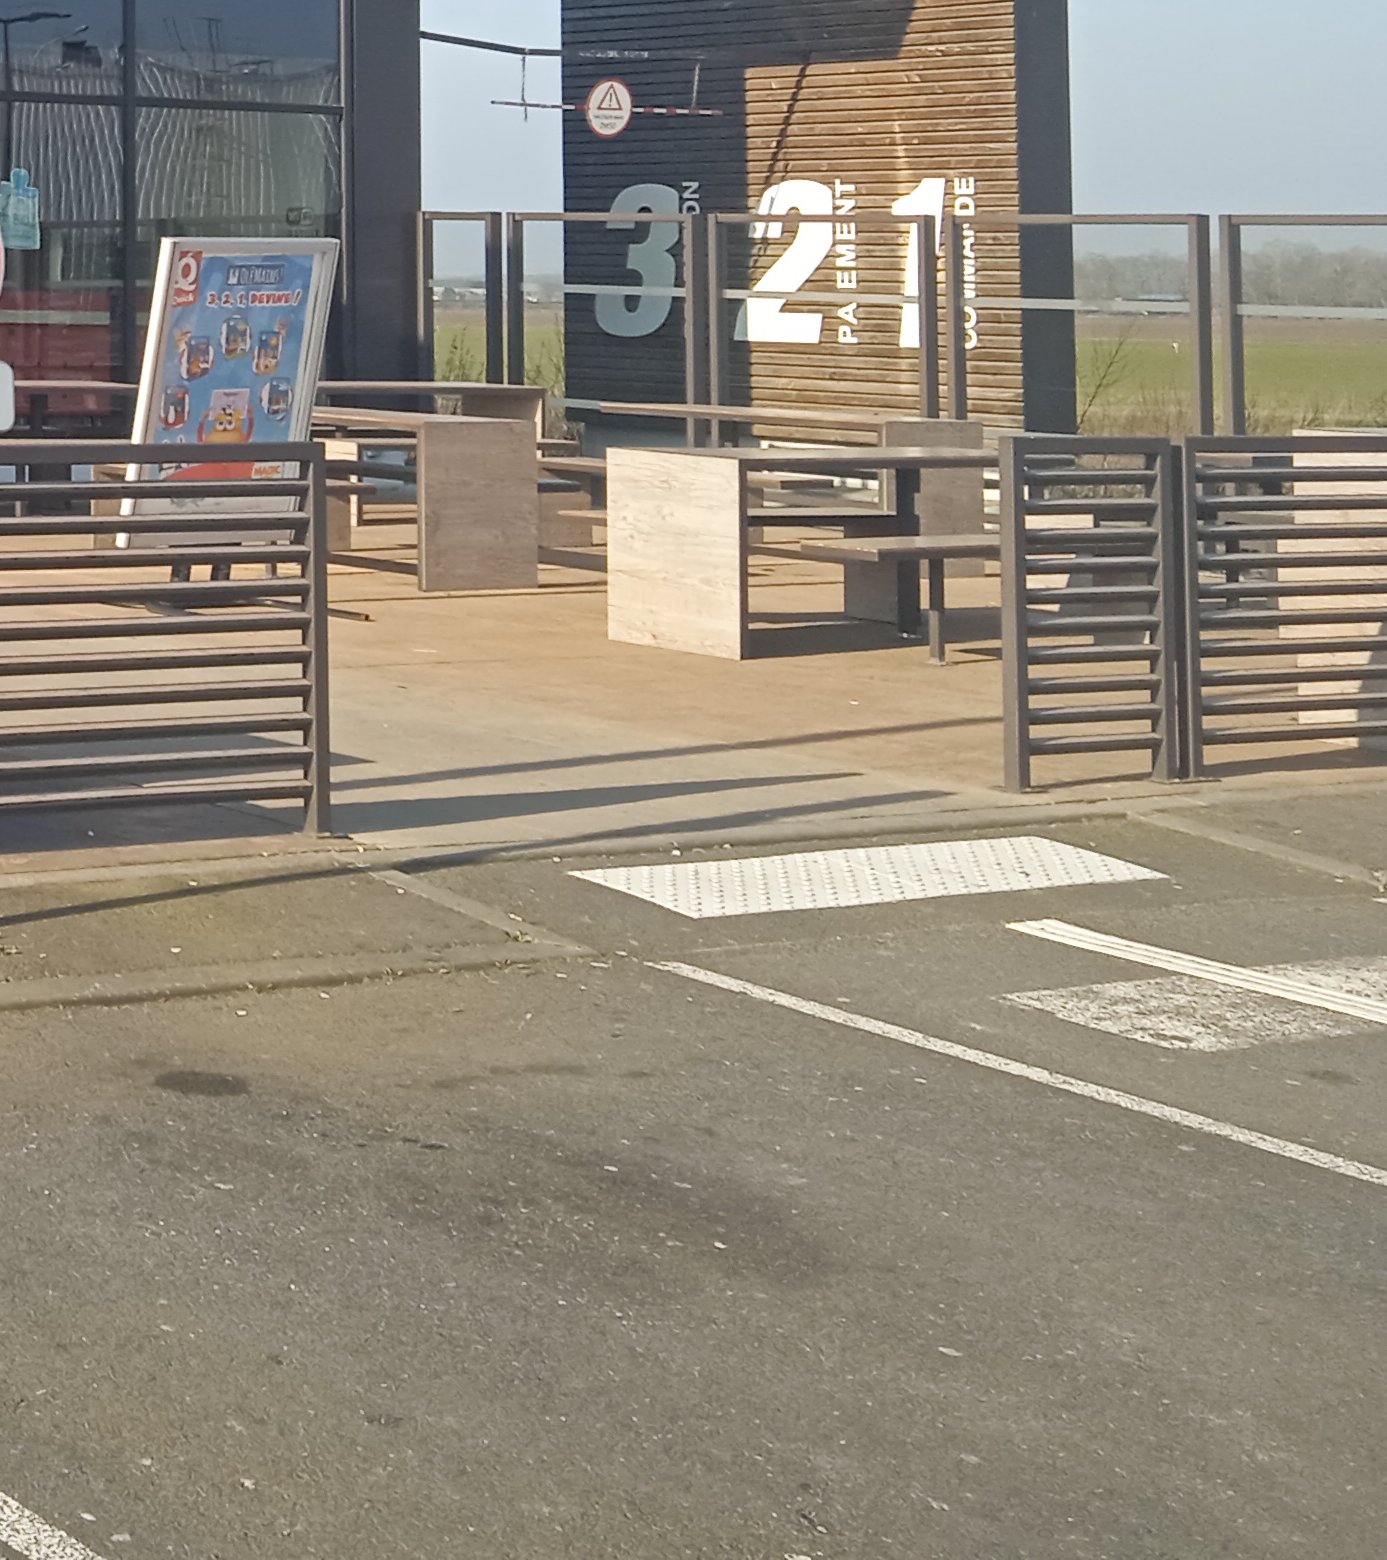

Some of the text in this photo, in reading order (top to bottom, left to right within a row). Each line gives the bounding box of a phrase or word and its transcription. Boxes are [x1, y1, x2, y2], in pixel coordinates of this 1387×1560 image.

[595, 183, 680, 338] 3
[734, 179, 833, 343] 2
[834, 178, 859, 344] PAEMENT
[892, 177, 946, 348] 1
